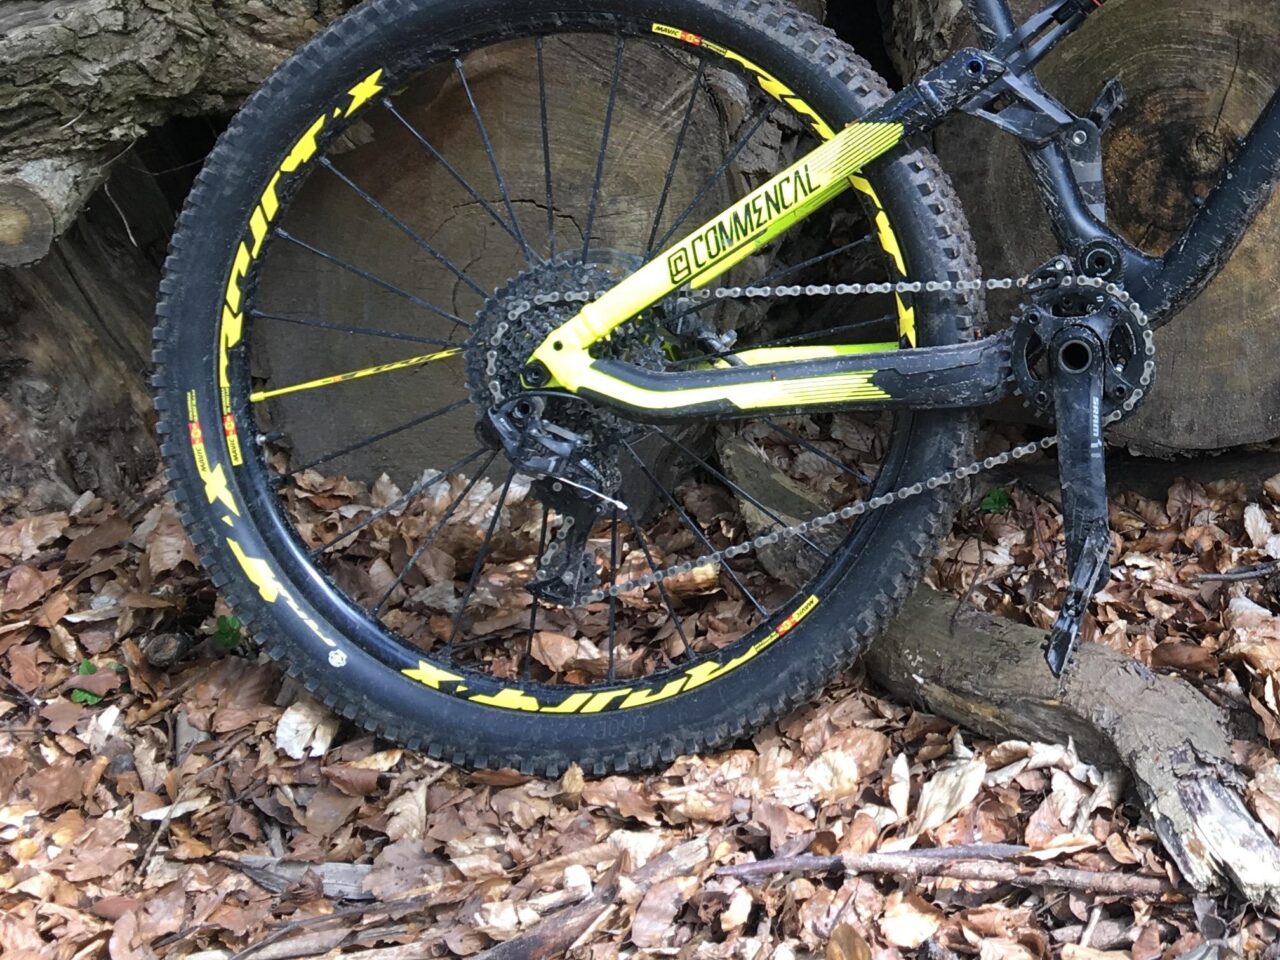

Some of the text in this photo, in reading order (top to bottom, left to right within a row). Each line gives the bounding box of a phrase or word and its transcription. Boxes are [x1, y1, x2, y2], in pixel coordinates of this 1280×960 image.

[654, 25, 680, 37] MAVIC
[691, 163, 821, 269] COMMENCAL
[1092, 395, 1100, 437] SRAM
